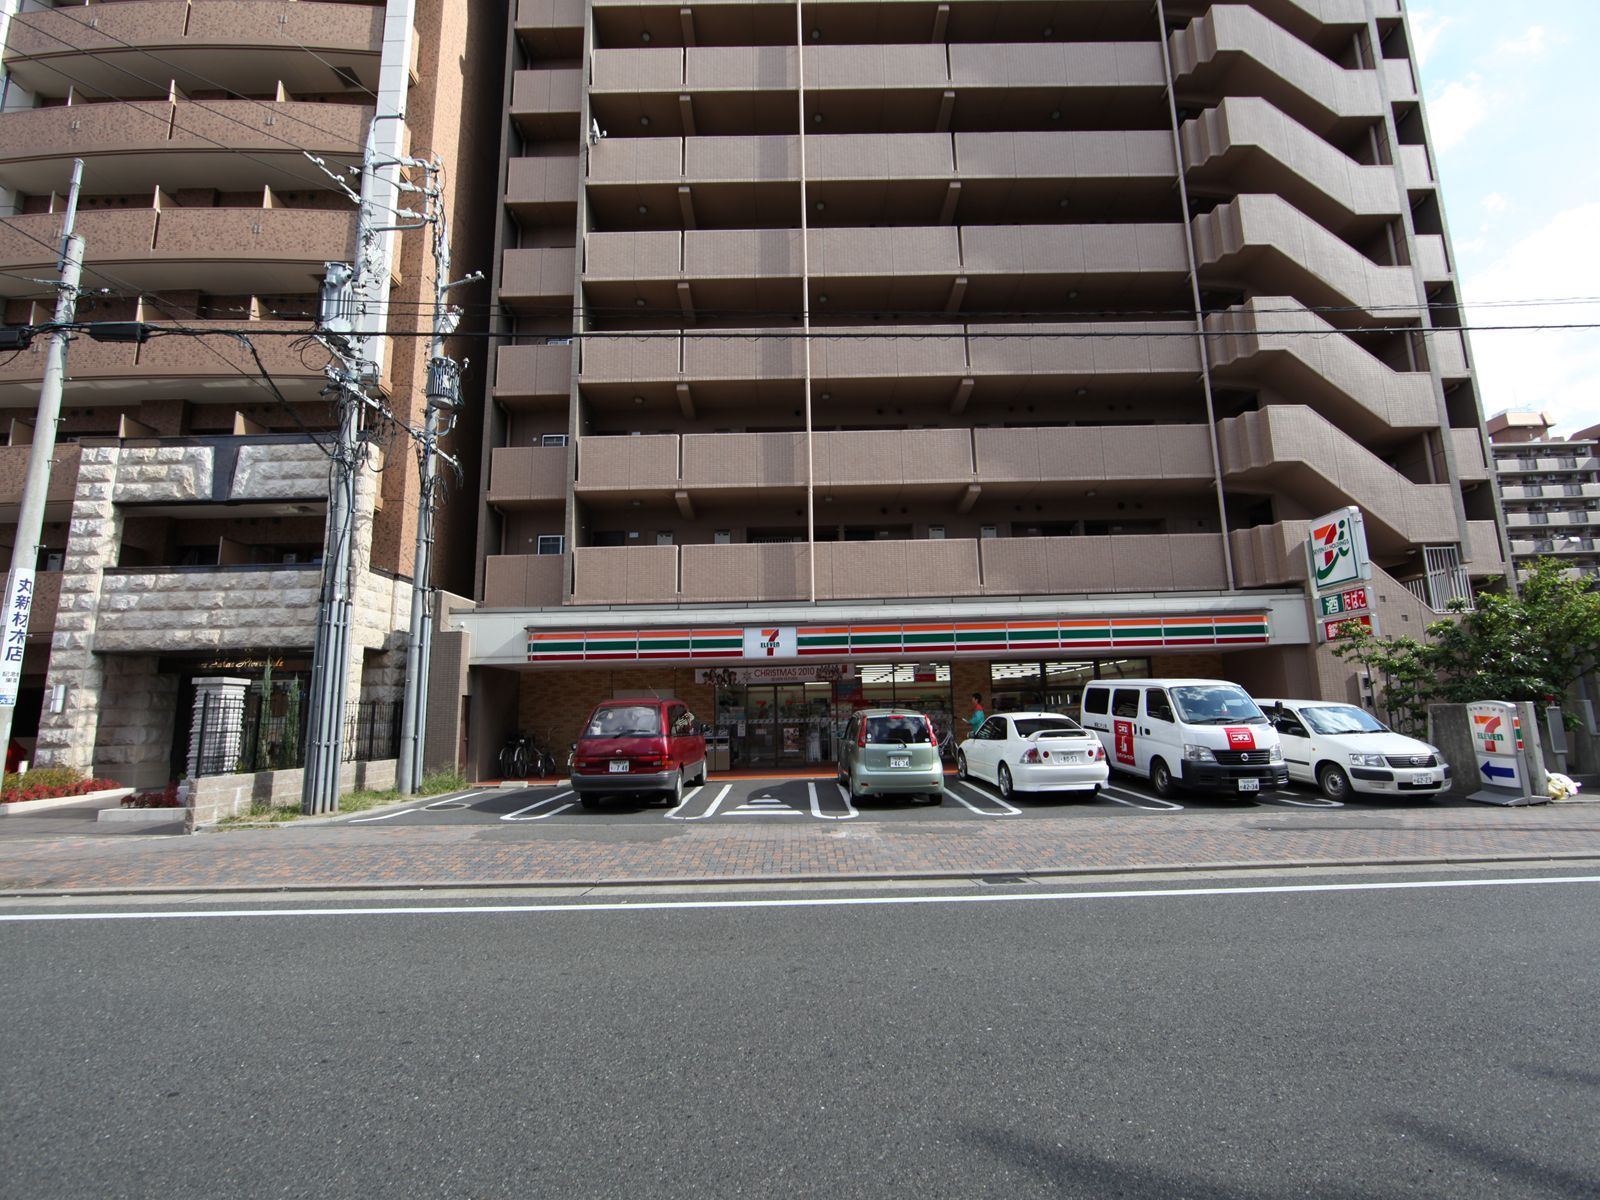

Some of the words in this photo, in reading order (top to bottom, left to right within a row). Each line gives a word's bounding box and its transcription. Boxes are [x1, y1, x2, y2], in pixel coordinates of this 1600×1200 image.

[1325, 596, 1339, 615] 酒
[1343, 590, 1366, 611] たばこ
[5, 578, 32, 661] 丸新材木店
[761, 629, 779, 656] 7
[754, 668, 797, 678] CHRISTMAS
[798, 667, 815, 676] 2010
[1473, 716, 1502, 752] 7
